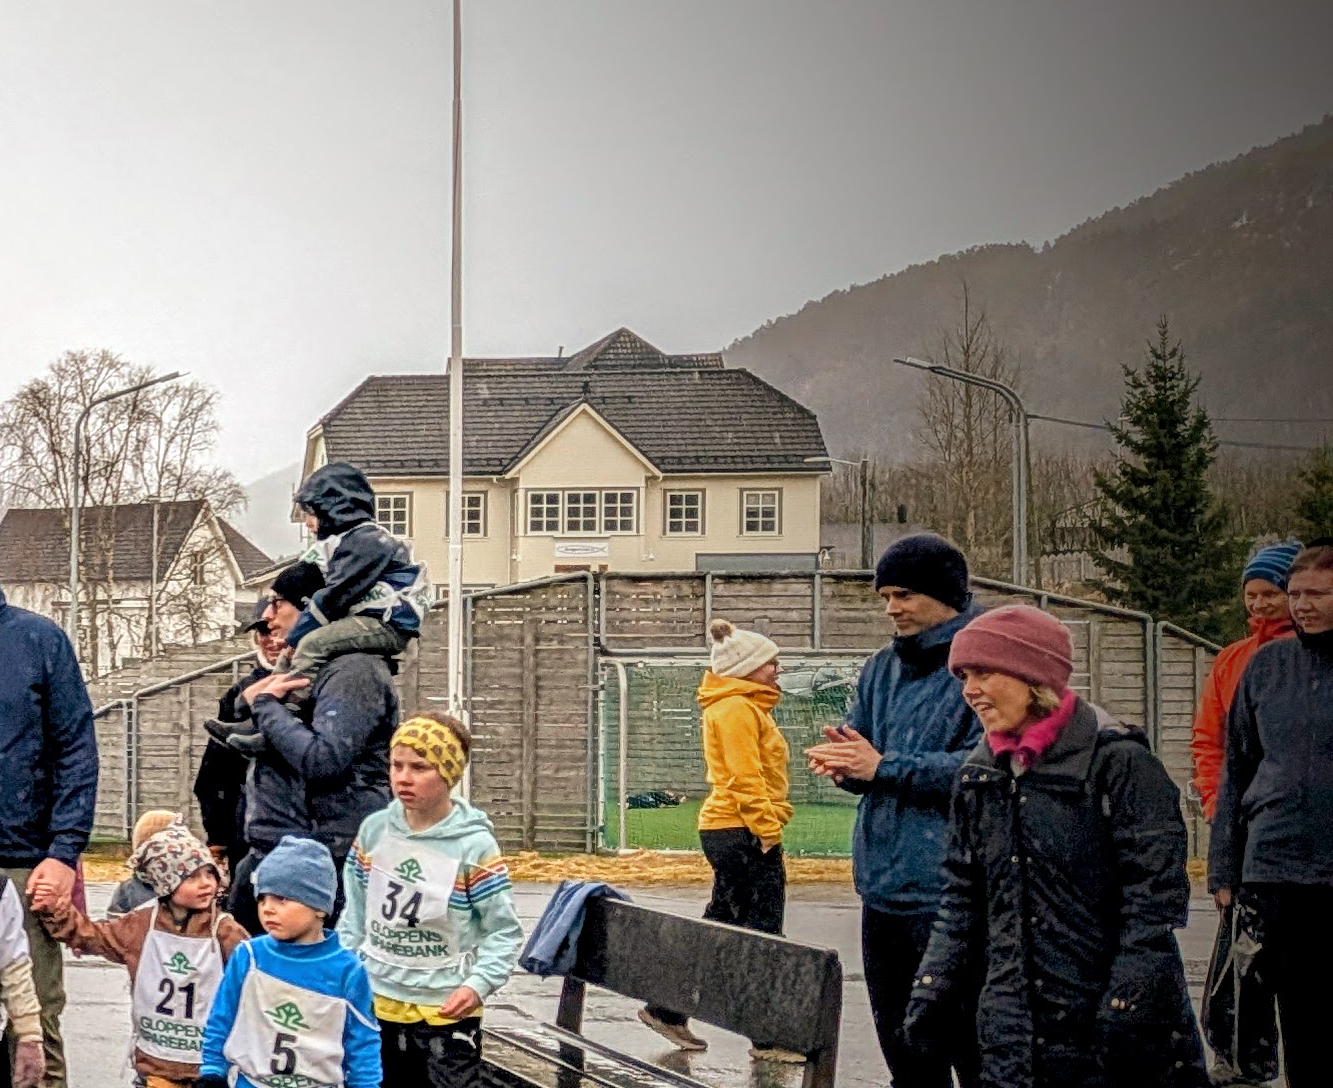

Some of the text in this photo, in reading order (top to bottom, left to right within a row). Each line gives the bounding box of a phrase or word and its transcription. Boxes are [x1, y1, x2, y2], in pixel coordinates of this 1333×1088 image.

[382, 880, 423, 928] 34
[156, 978, 196, 1020] 21
[270, 1032, 298, 1075] 5
